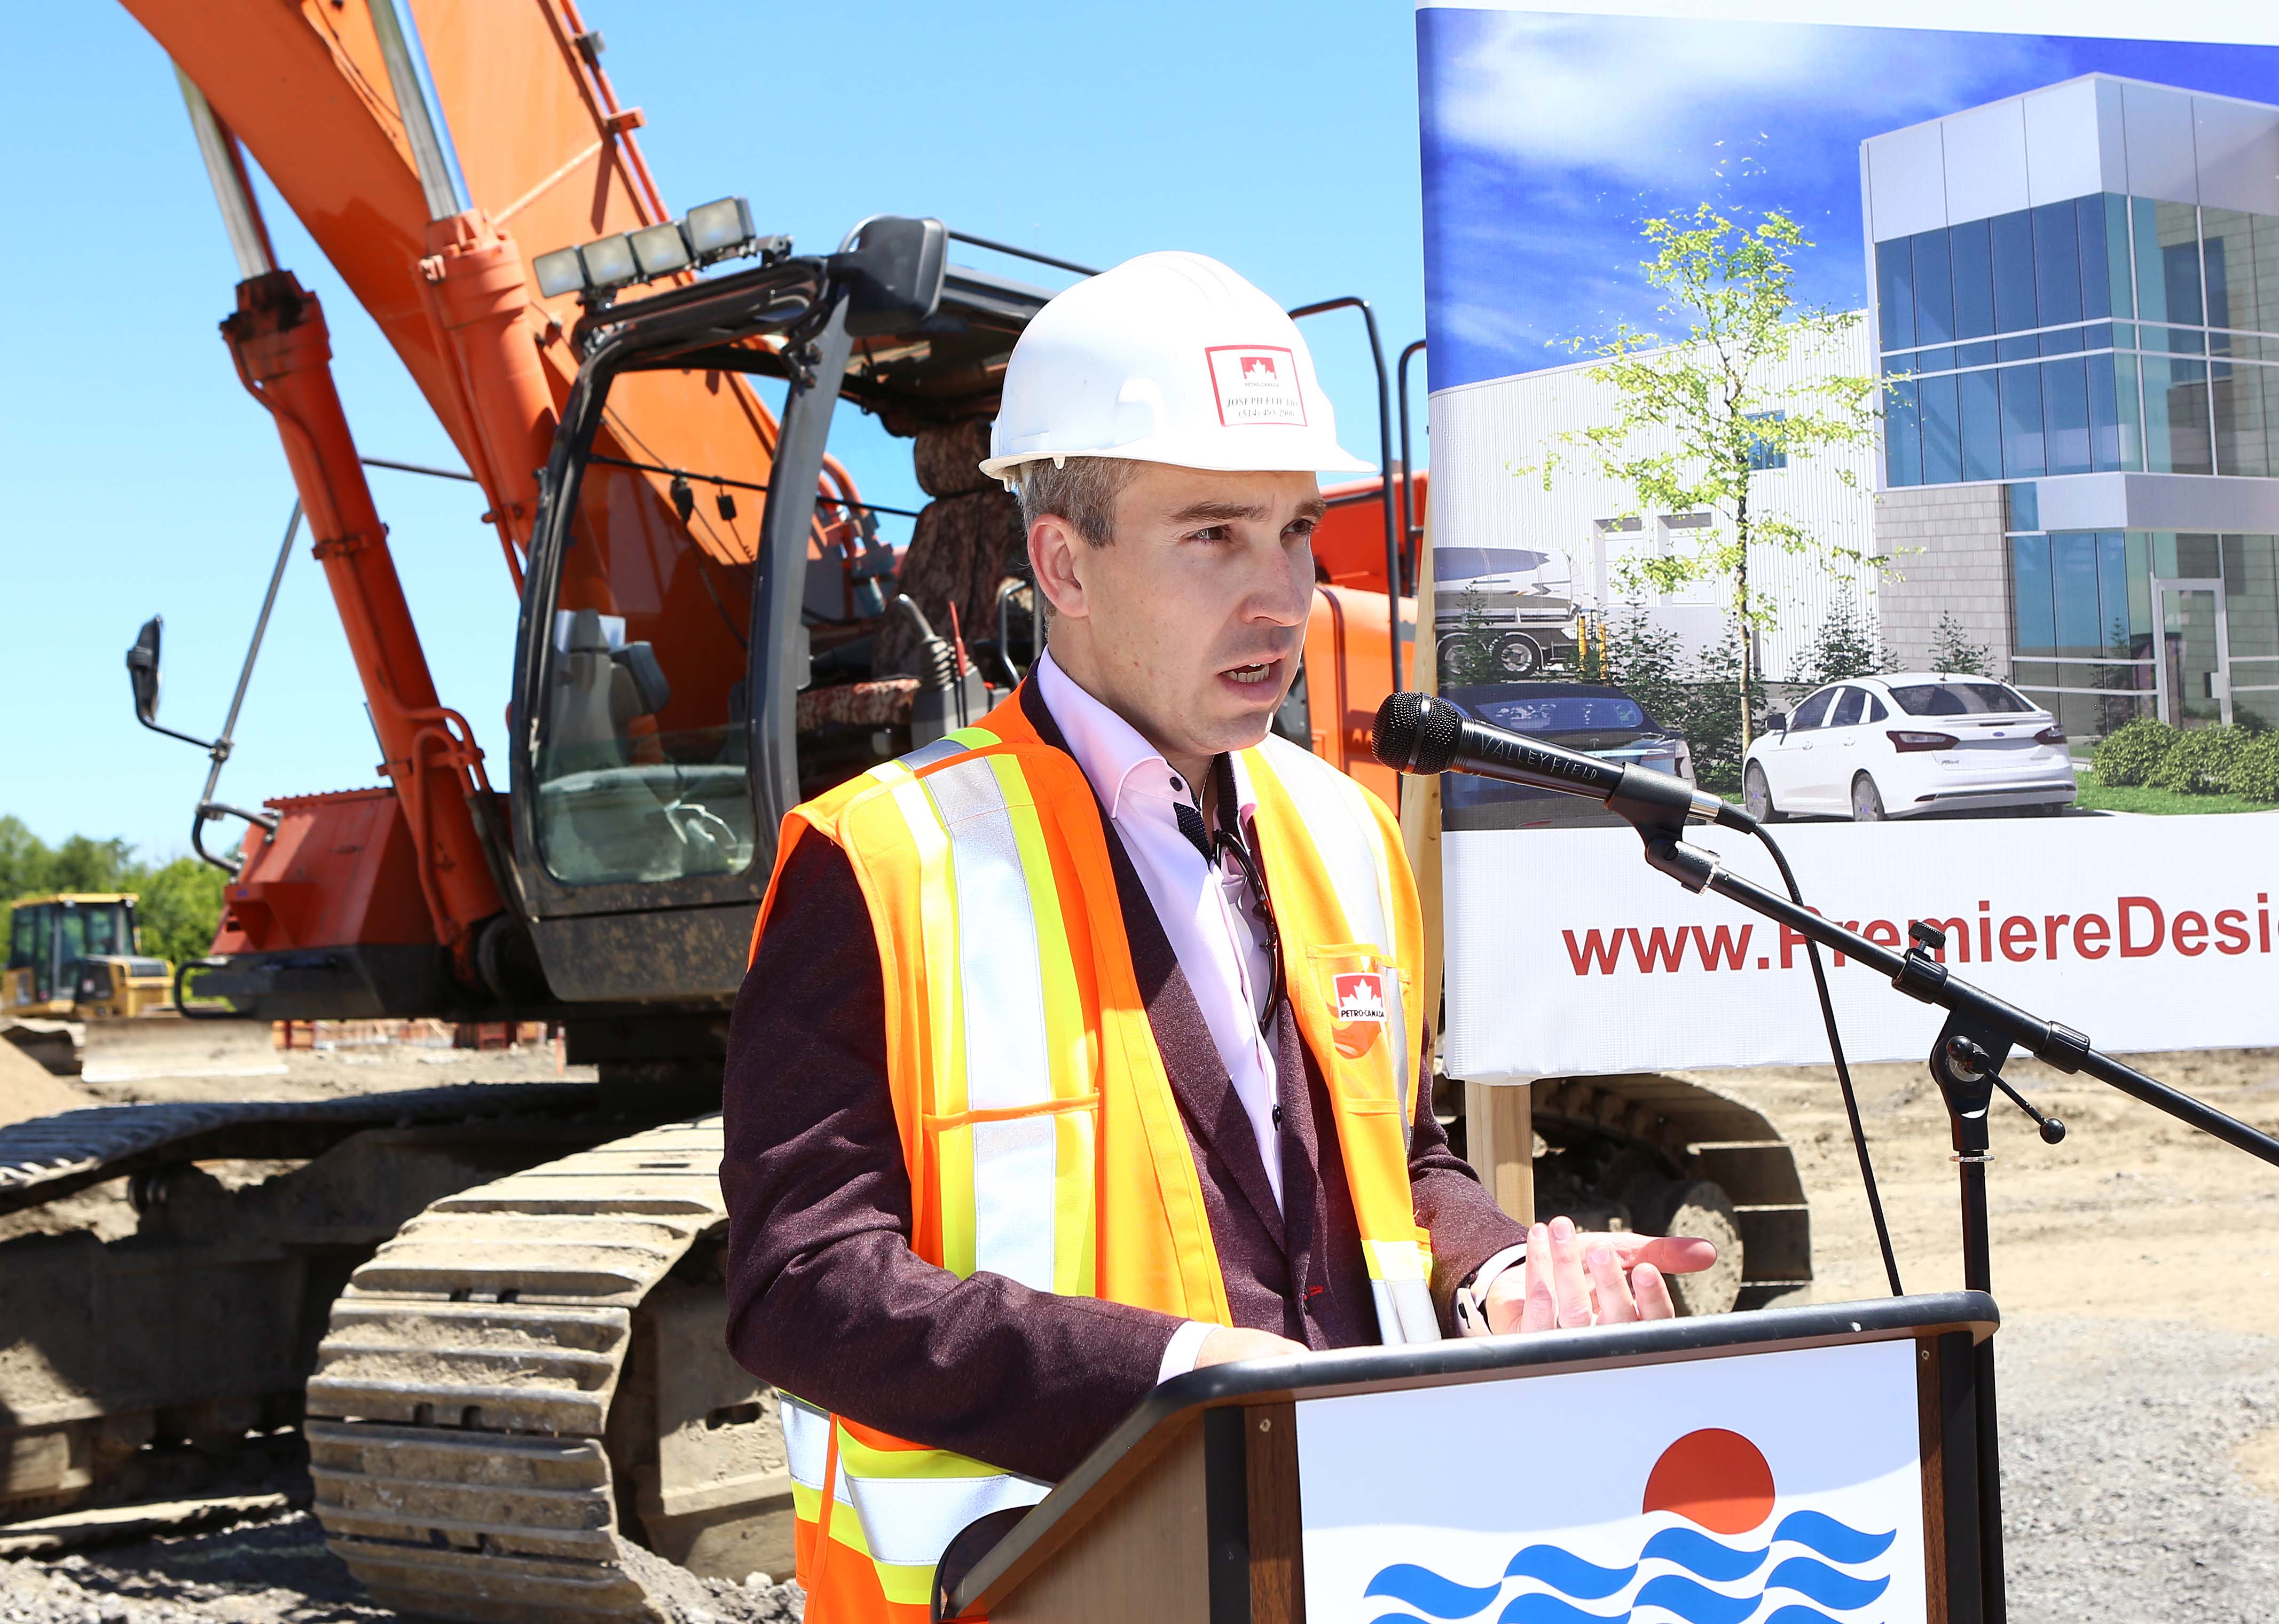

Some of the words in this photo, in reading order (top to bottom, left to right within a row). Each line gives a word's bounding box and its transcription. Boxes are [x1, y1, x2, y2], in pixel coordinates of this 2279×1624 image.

[1227, 397, 1263, 407] JOSEPH
[1238, 409, 1260, 418] (514)
[1561, 893, 2279, 975] www.PremiereDesi
